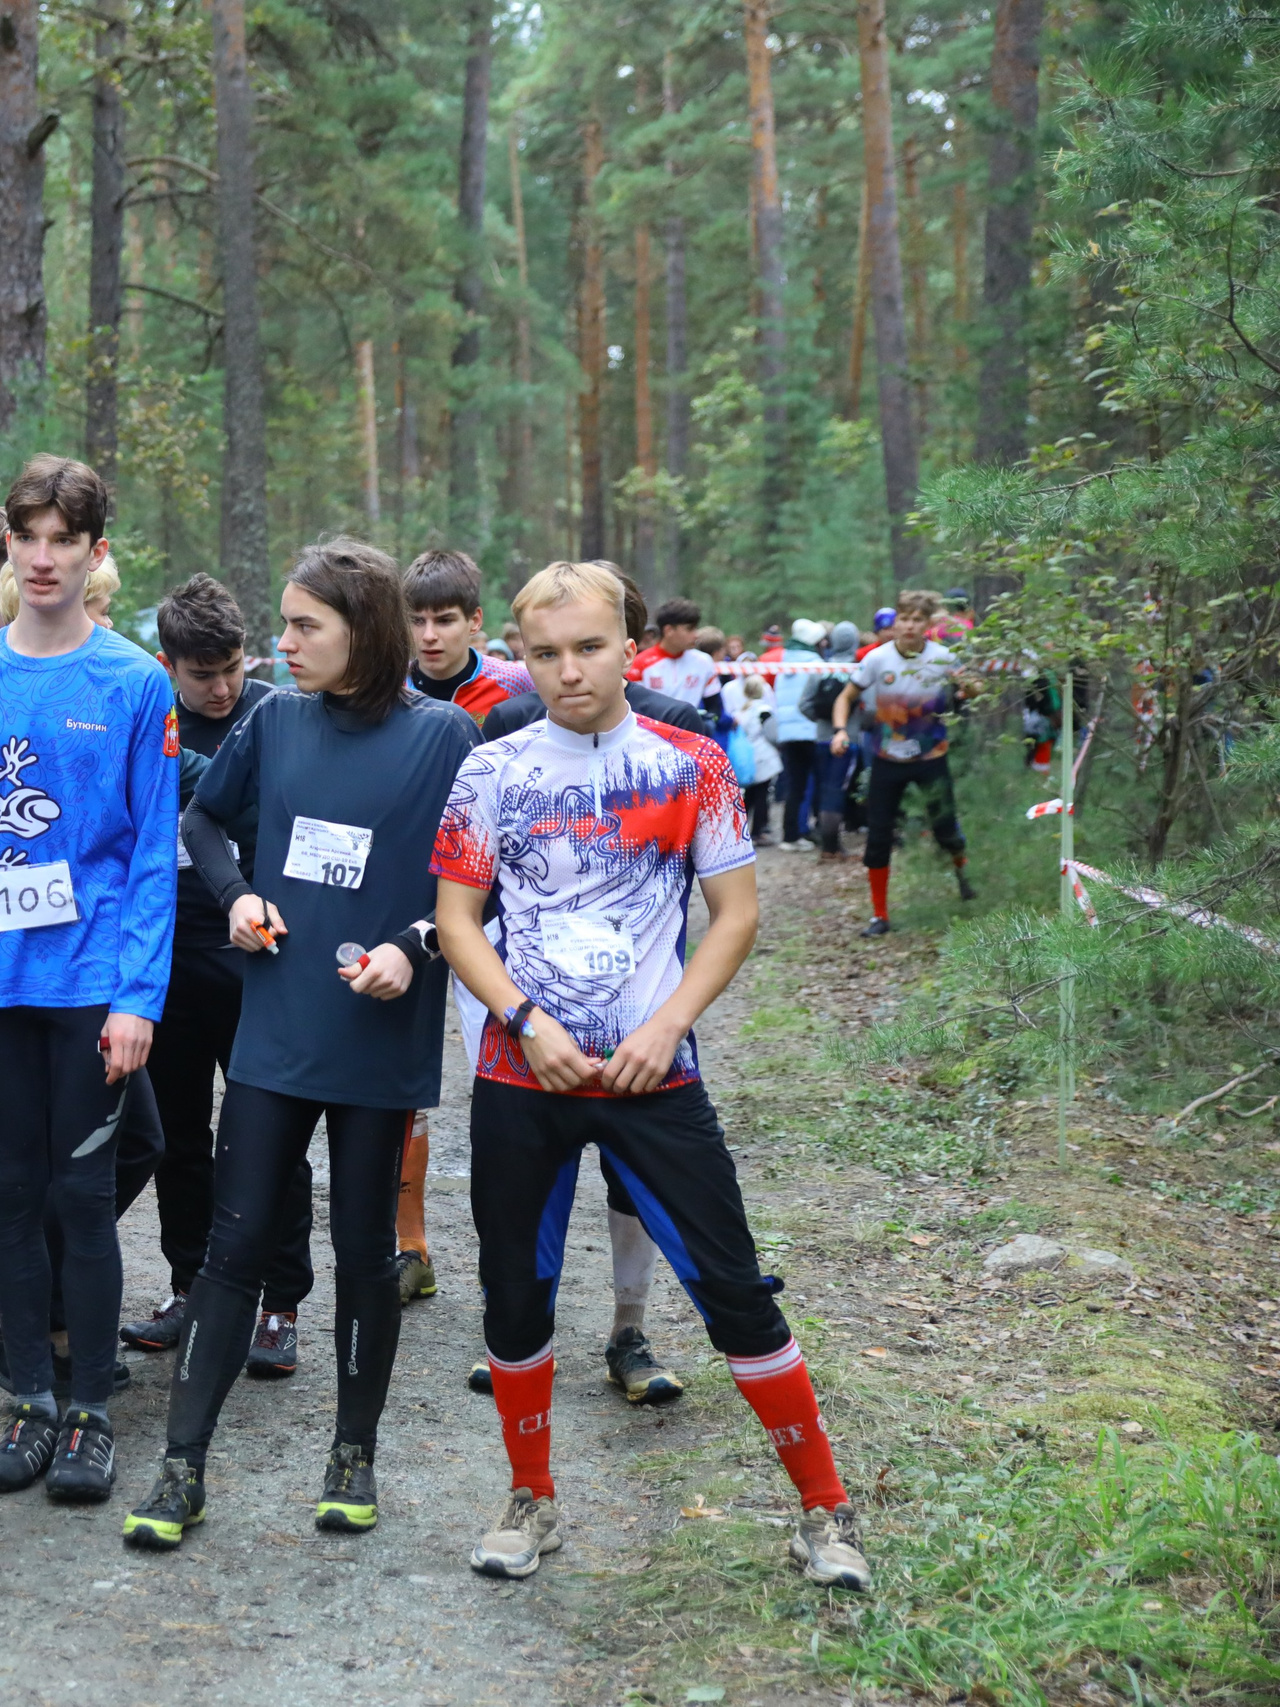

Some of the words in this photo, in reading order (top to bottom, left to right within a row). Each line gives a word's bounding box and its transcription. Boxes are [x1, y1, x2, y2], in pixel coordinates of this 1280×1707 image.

[66, 719, 107, 732] Бутюгин
[321, 861, 362, 888] 107
[584, 949, 631, 973] 109
[184, 1319, 199, 1366] NORD
[351, 1318, 359, 1362] NORD
